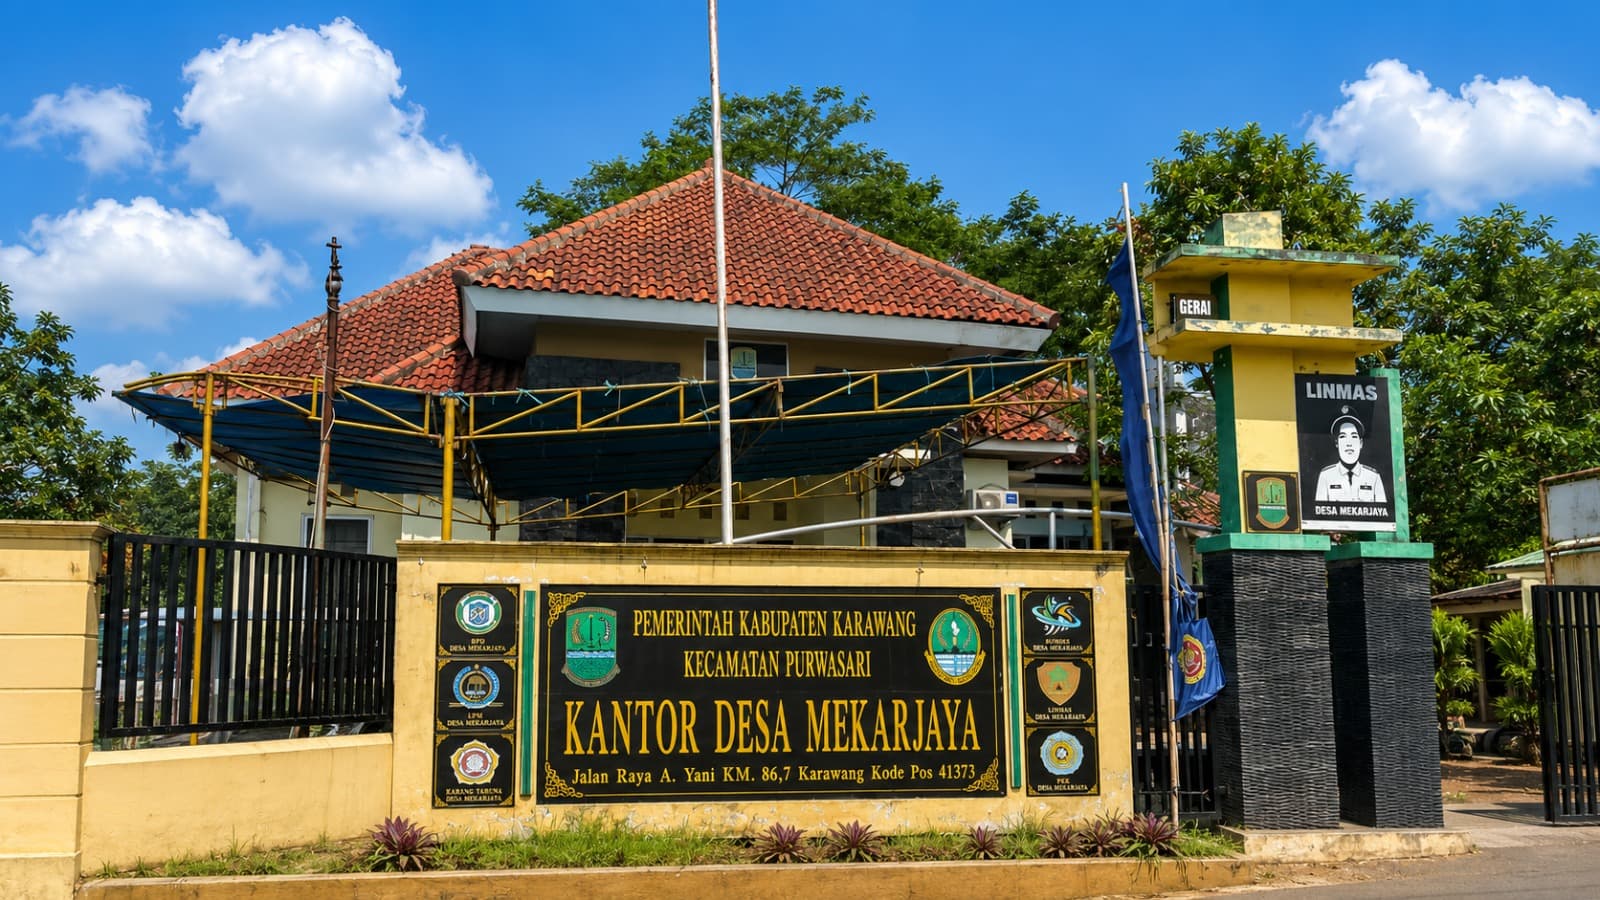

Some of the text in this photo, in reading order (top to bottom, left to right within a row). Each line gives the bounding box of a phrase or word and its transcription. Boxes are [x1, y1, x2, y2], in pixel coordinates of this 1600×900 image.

[1179, 298, 1212, 316] GERAI
[1306, 382, 1378, 401] LINMAS
[1315, 505, 1389, 517] DESA MEKARJAYA
[633, 609, 917, 637] PEMERINTAH KABUPATEN KARAWANG
[467, 644, 506, 652] MEKARJAYA
[683, 650, 872, 678] KECAMATAN PURWASARI
[465, 719, 504, 727] MEKARJAYA
[564, 699, 981, 755] KANTOR DESA MEKARJAYA
[572, 764, 976, 787] Jalan Raya A. Yani KM. 86,7 Karawang Kode Pos 41373
